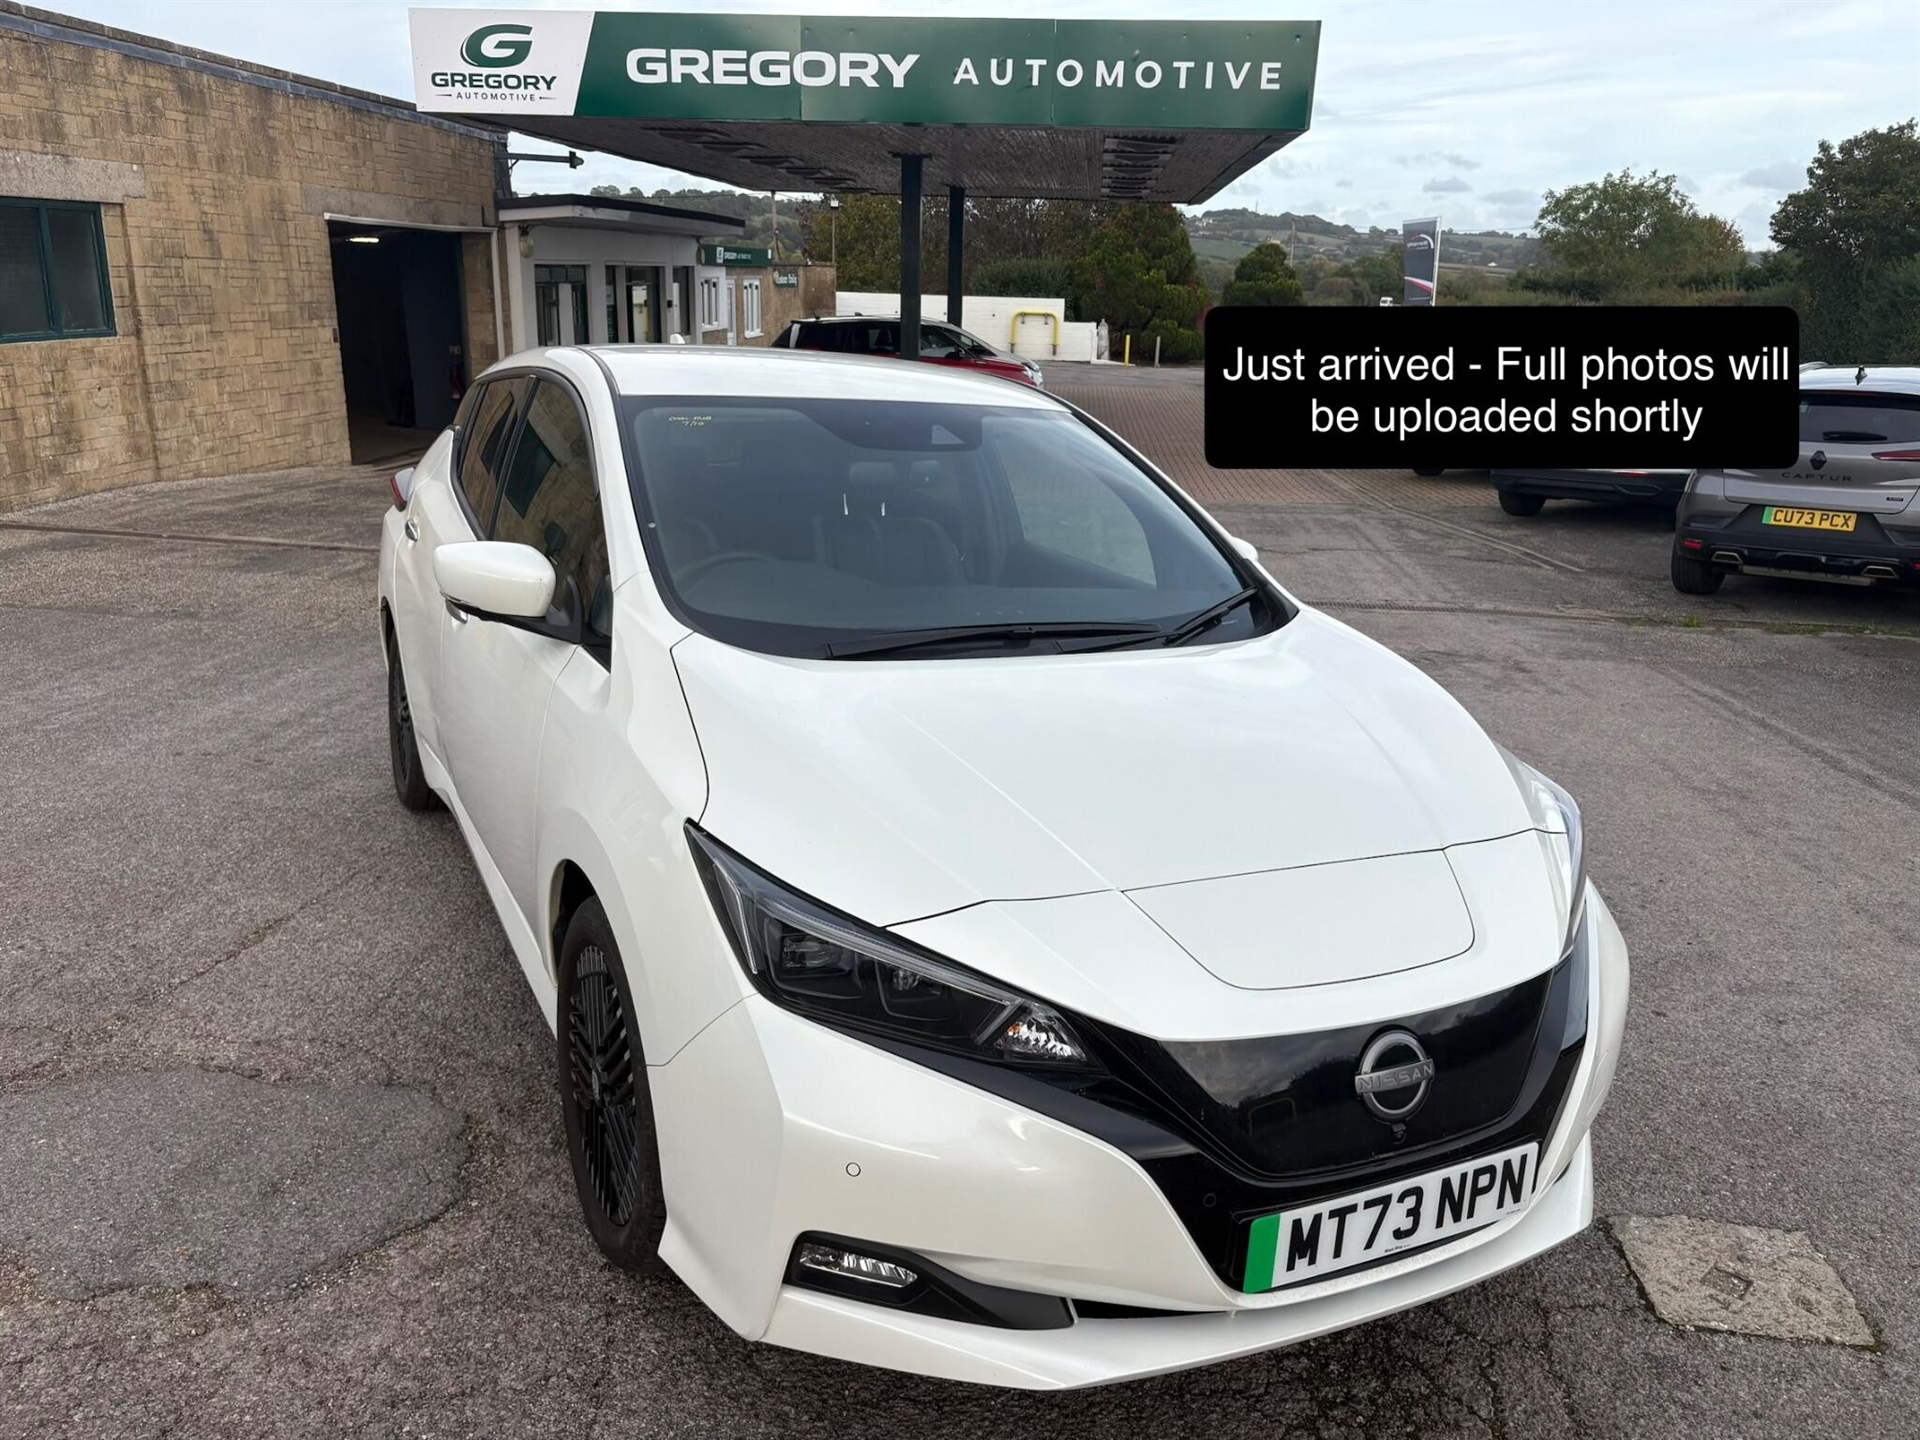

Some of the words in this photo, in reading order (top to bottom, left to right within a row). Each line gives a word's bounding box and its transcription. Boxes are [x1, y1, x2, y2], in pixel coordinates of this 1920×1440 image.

[460, 24, 533, 68] G
[431, 72, 557, 90] GREGORY
[626, 48, 921, 88] GREGORY
[953, 58, 1282, 90] AUTOMOTIVE
[456, 92, 535, 101] AUTOMOTIVE
[1781, 472, 1852, 482] CAPTUR
[1773, 509, 1815, 525] CU73
[1818, 512, 1852, 528] PCX
[1358, 1063, 1433, 1092] NISSAN
[1286, 1186, 1424, 1272] MT73
[1435, 1153, 1528, 1229] NPN
